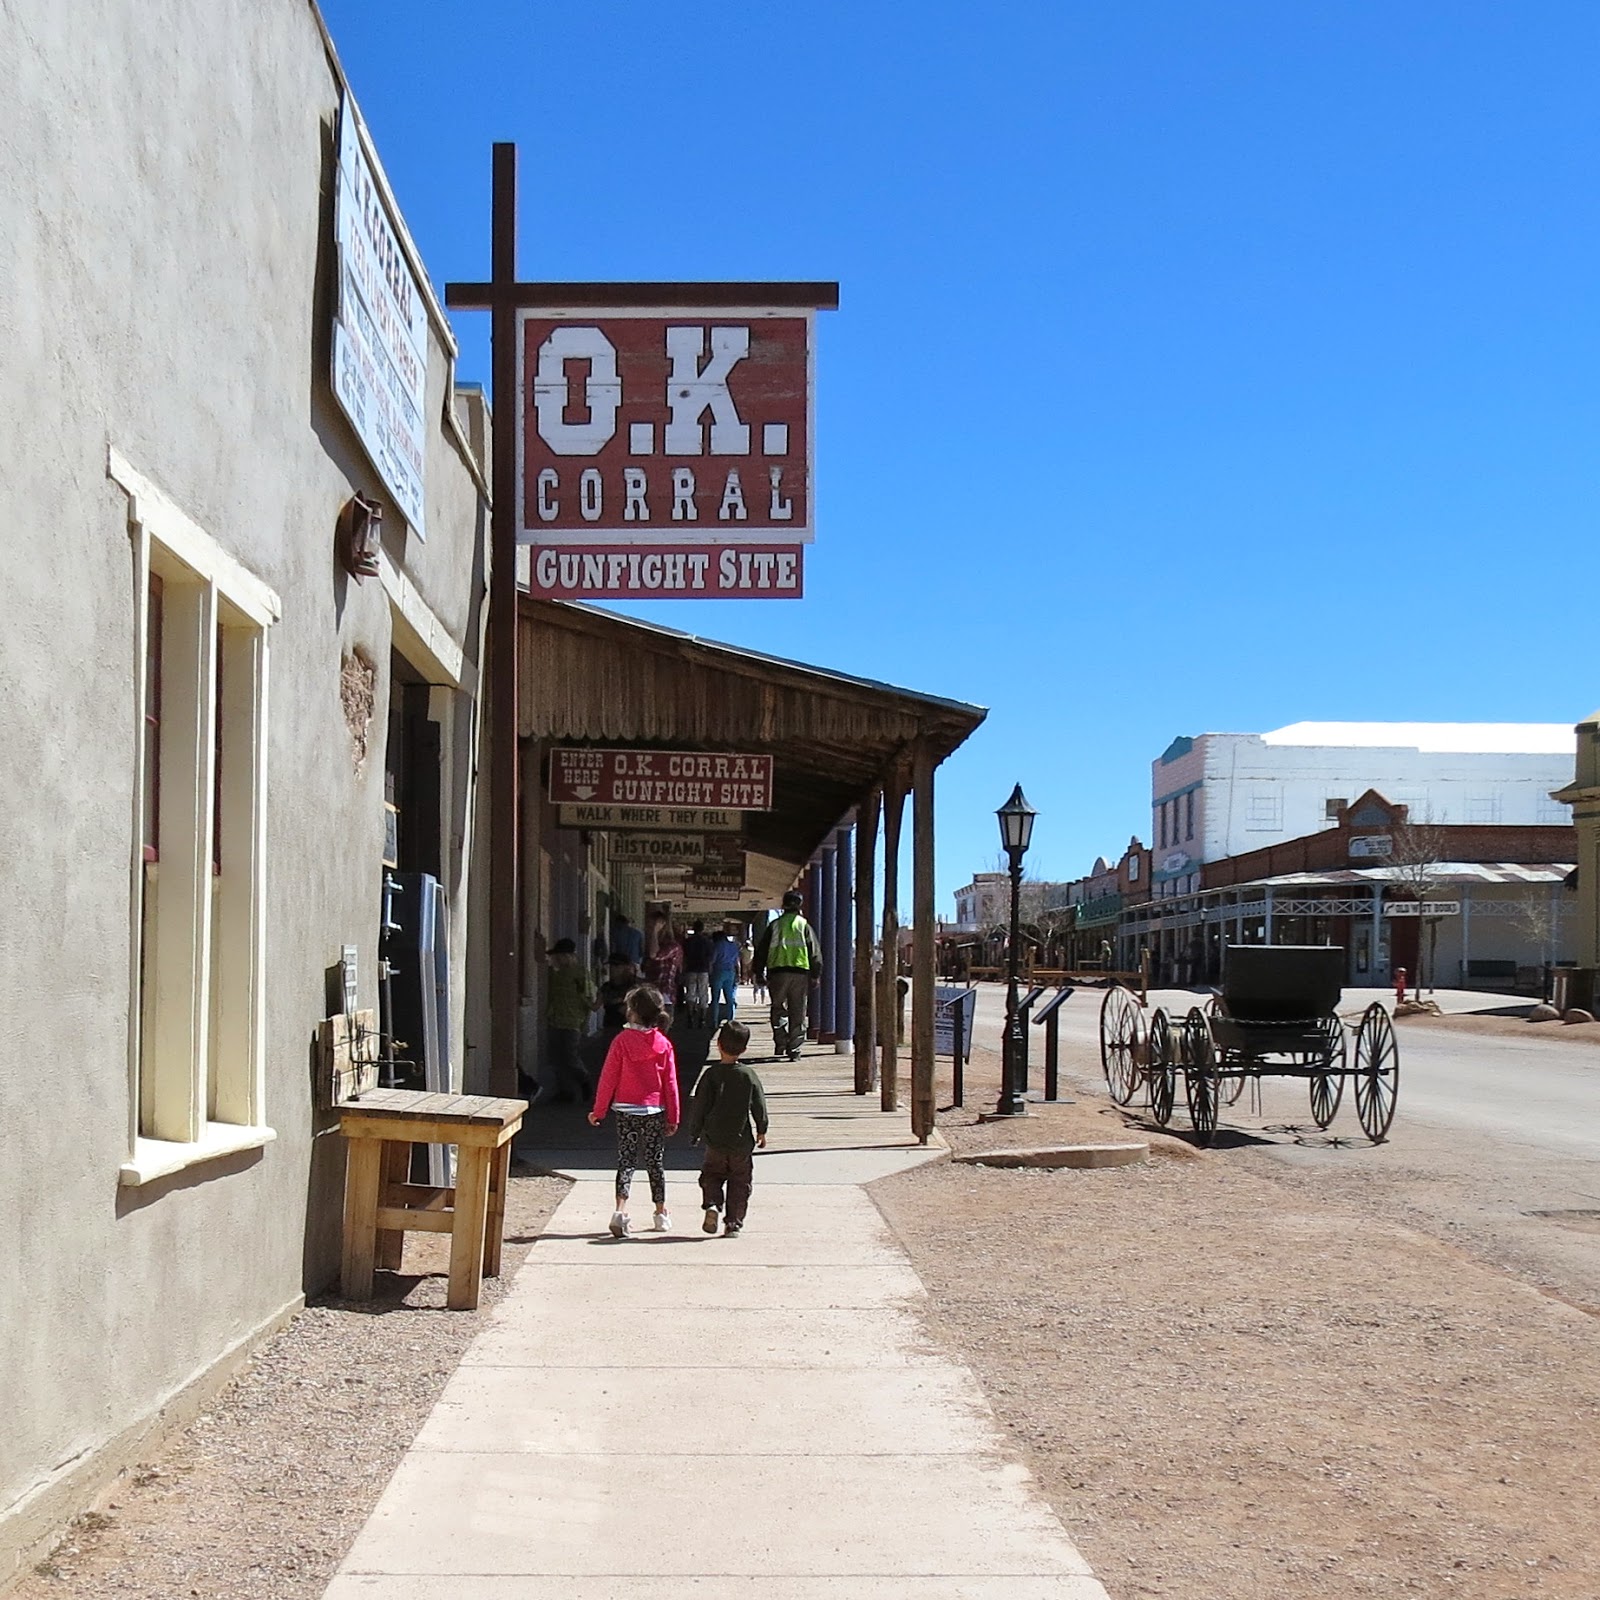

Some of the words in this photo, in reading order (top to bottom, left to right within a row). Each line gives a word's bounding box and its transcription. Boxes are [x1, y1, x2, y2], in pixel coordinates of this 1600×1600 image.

[373, 203, 413, 335] CORRAL
[533, 326, 789, 456] O.K.
[536, 467, 793, 522] CORRAL
[536, 549, 709, 590] GUNFIGHT
[719, 549, 797, 590] SITE
[561, 752, 604, 768] ENTER
[614, 754, 660, 777] O.K.
[669, 756, 765, 780] CORRAL
[564, 769, 600, 785] HERE
[612, 779, 714, 803] GUNFIGHT
[720, 783, 765, 806] SITE
[620, 808, 661, 823] WHERE
[669, 810, 698, 824] THEY
[614, 838, 704, 857] HISTORAMA
